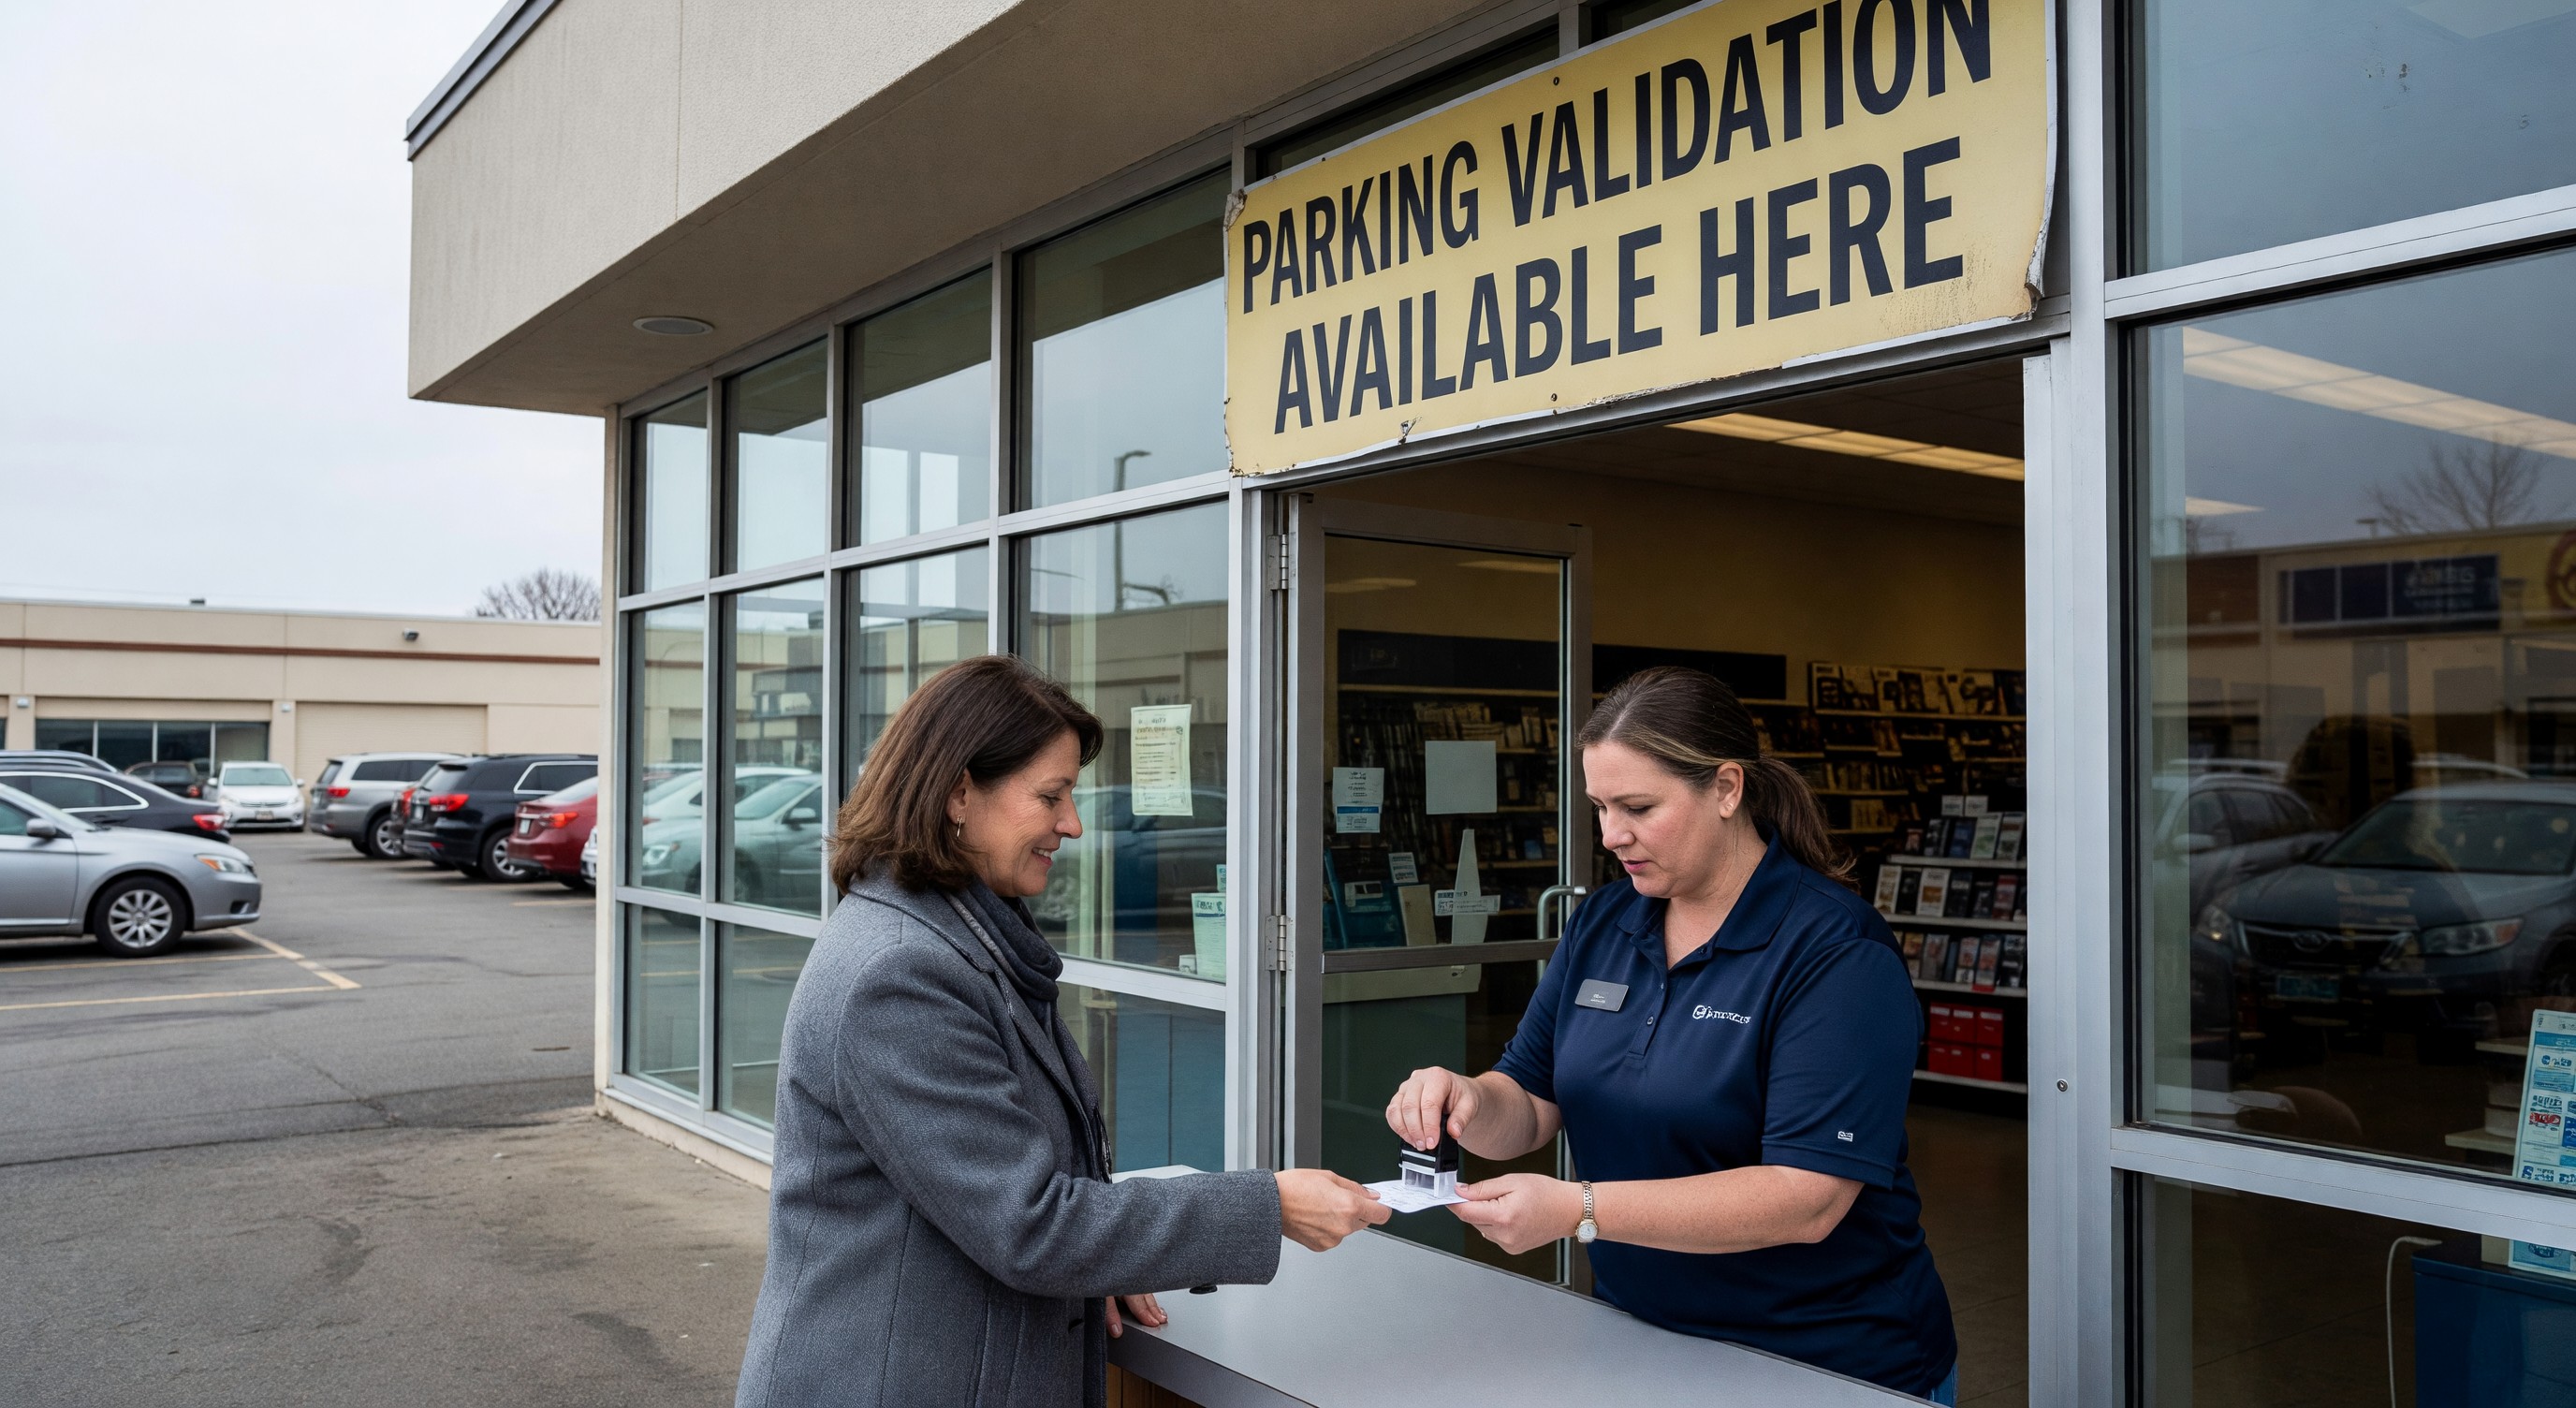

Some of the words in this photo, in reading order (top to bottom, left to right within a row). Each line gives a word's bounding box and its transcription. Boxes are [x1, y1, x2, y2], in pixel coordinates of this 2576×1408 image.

[1243, 140, 1479, 315] PARKING
[1501, 0, 1991, 227] VALIDATION
[1275, 225, 1662, 435] AVAILABLE
[1700, 137, 1964, 337] HERE
